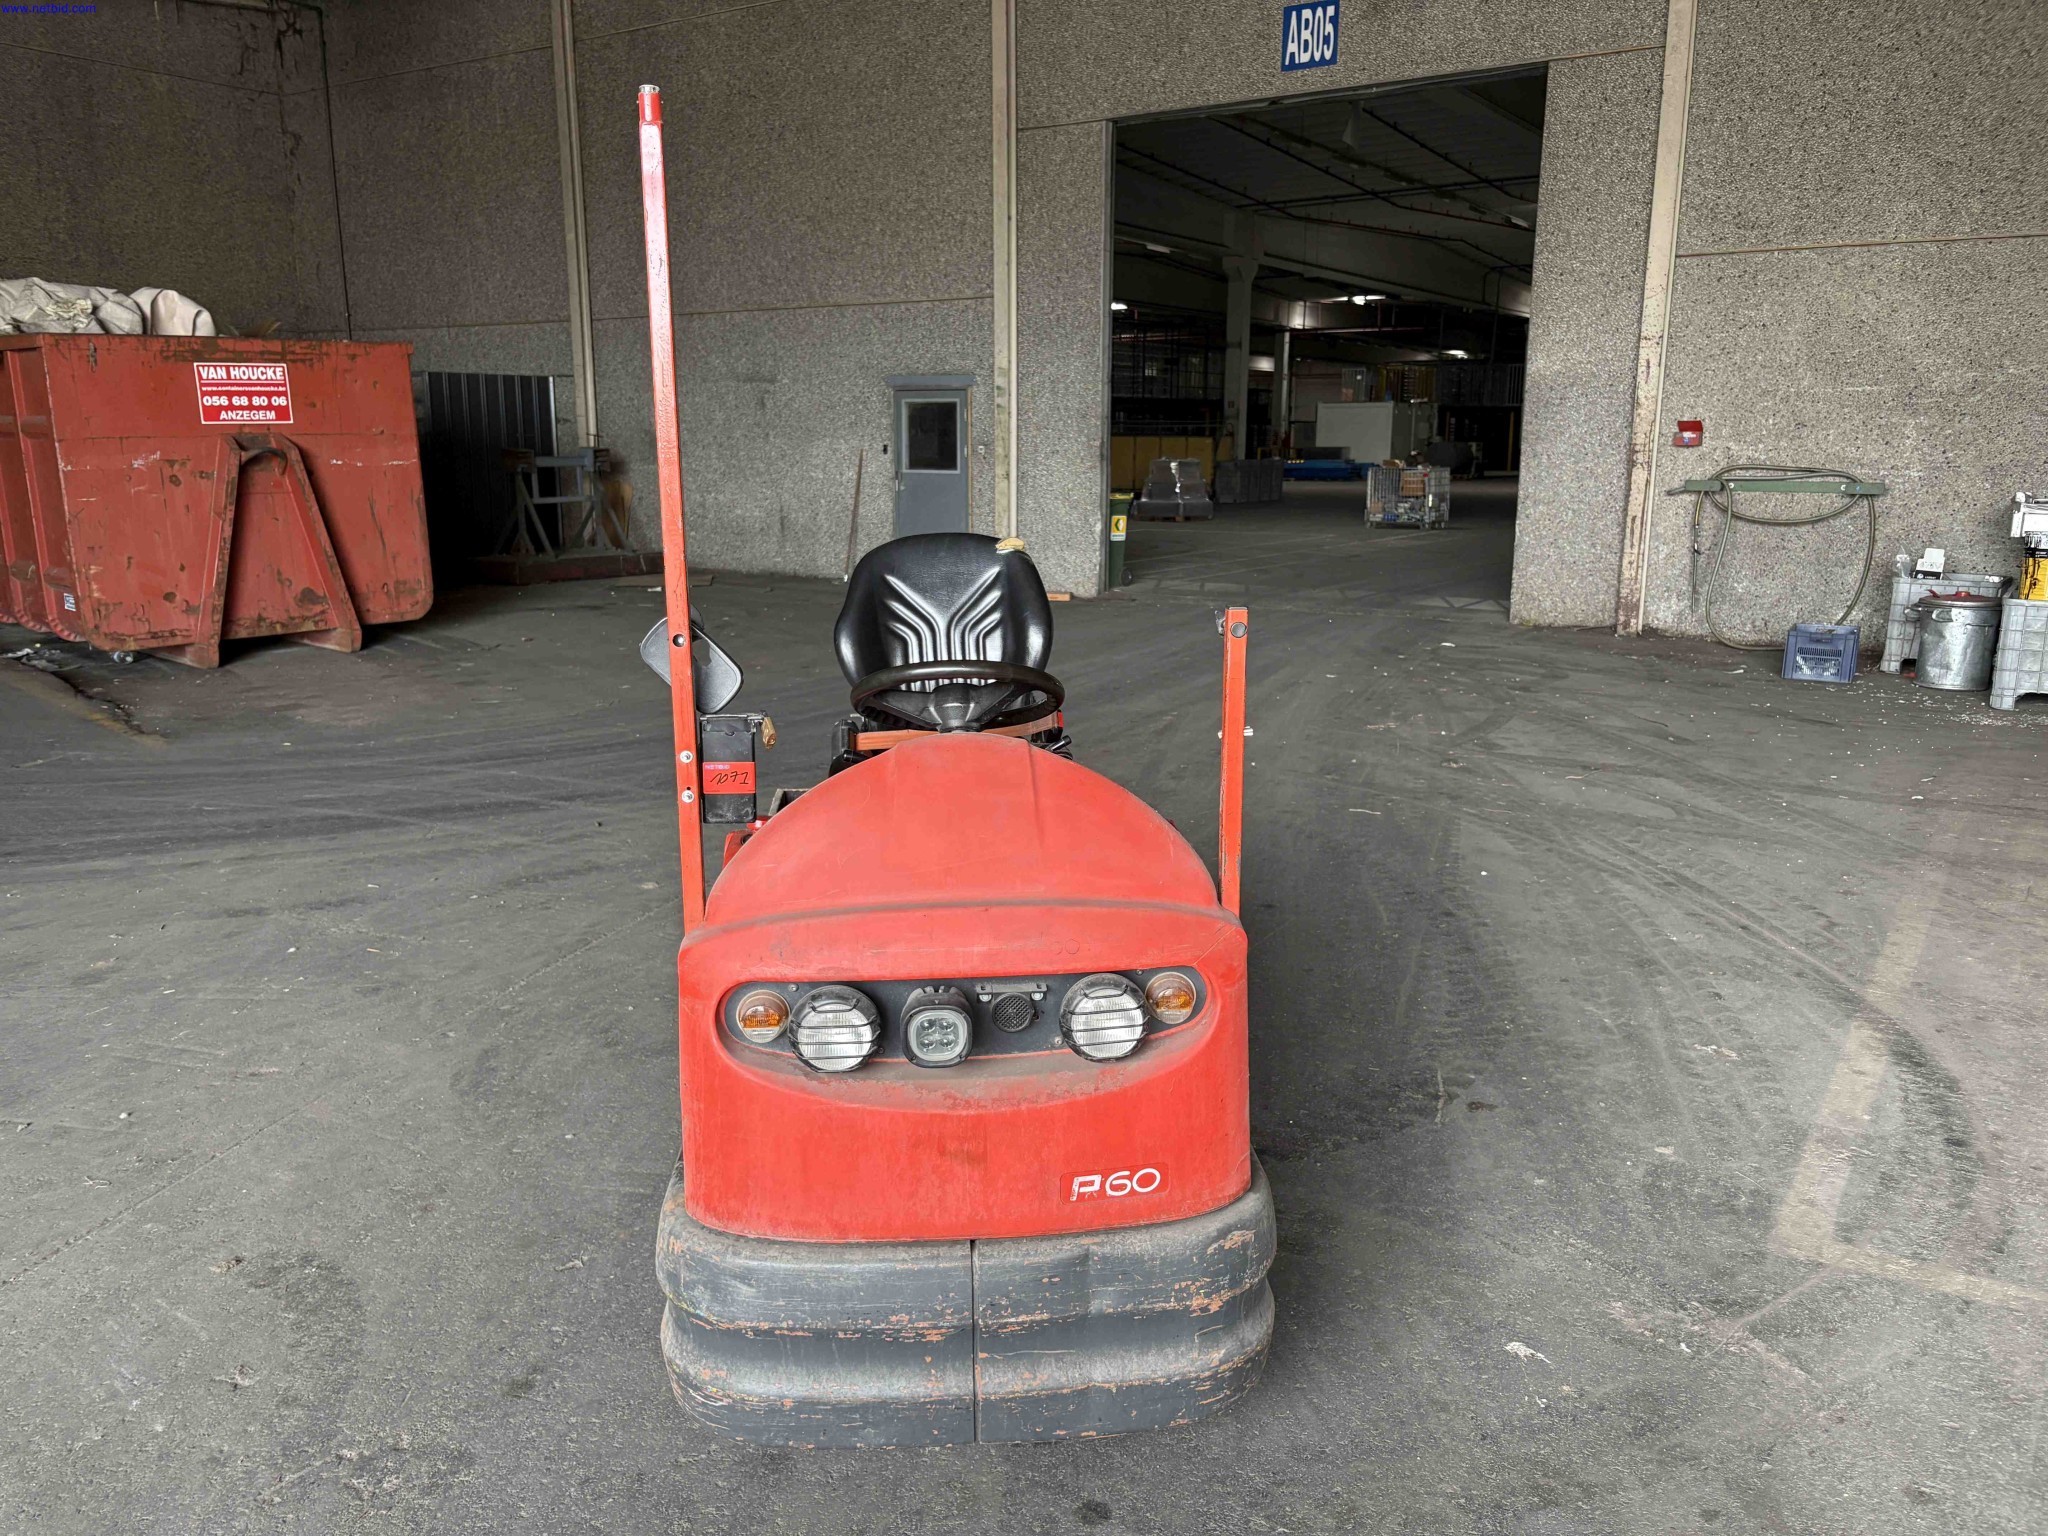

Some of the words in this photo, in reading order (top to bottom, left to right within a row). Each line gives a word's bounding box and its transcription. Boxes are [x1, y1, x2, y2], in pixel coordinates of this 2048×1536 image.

[1285, 5, 1335, 65] AB05
[199, 366, 227, 380] VAN
[229, 367, 284, 380] HOUCKE
[202, 395, 229, 406] 056
[231, 395, 249, 406] 68
[252, 395, 268, 406] 80
[271, 395, 287, 406] 06
[220, 410, 276, 420] ANZEGEM
[1069, 1167, 1161, 1202] P60
